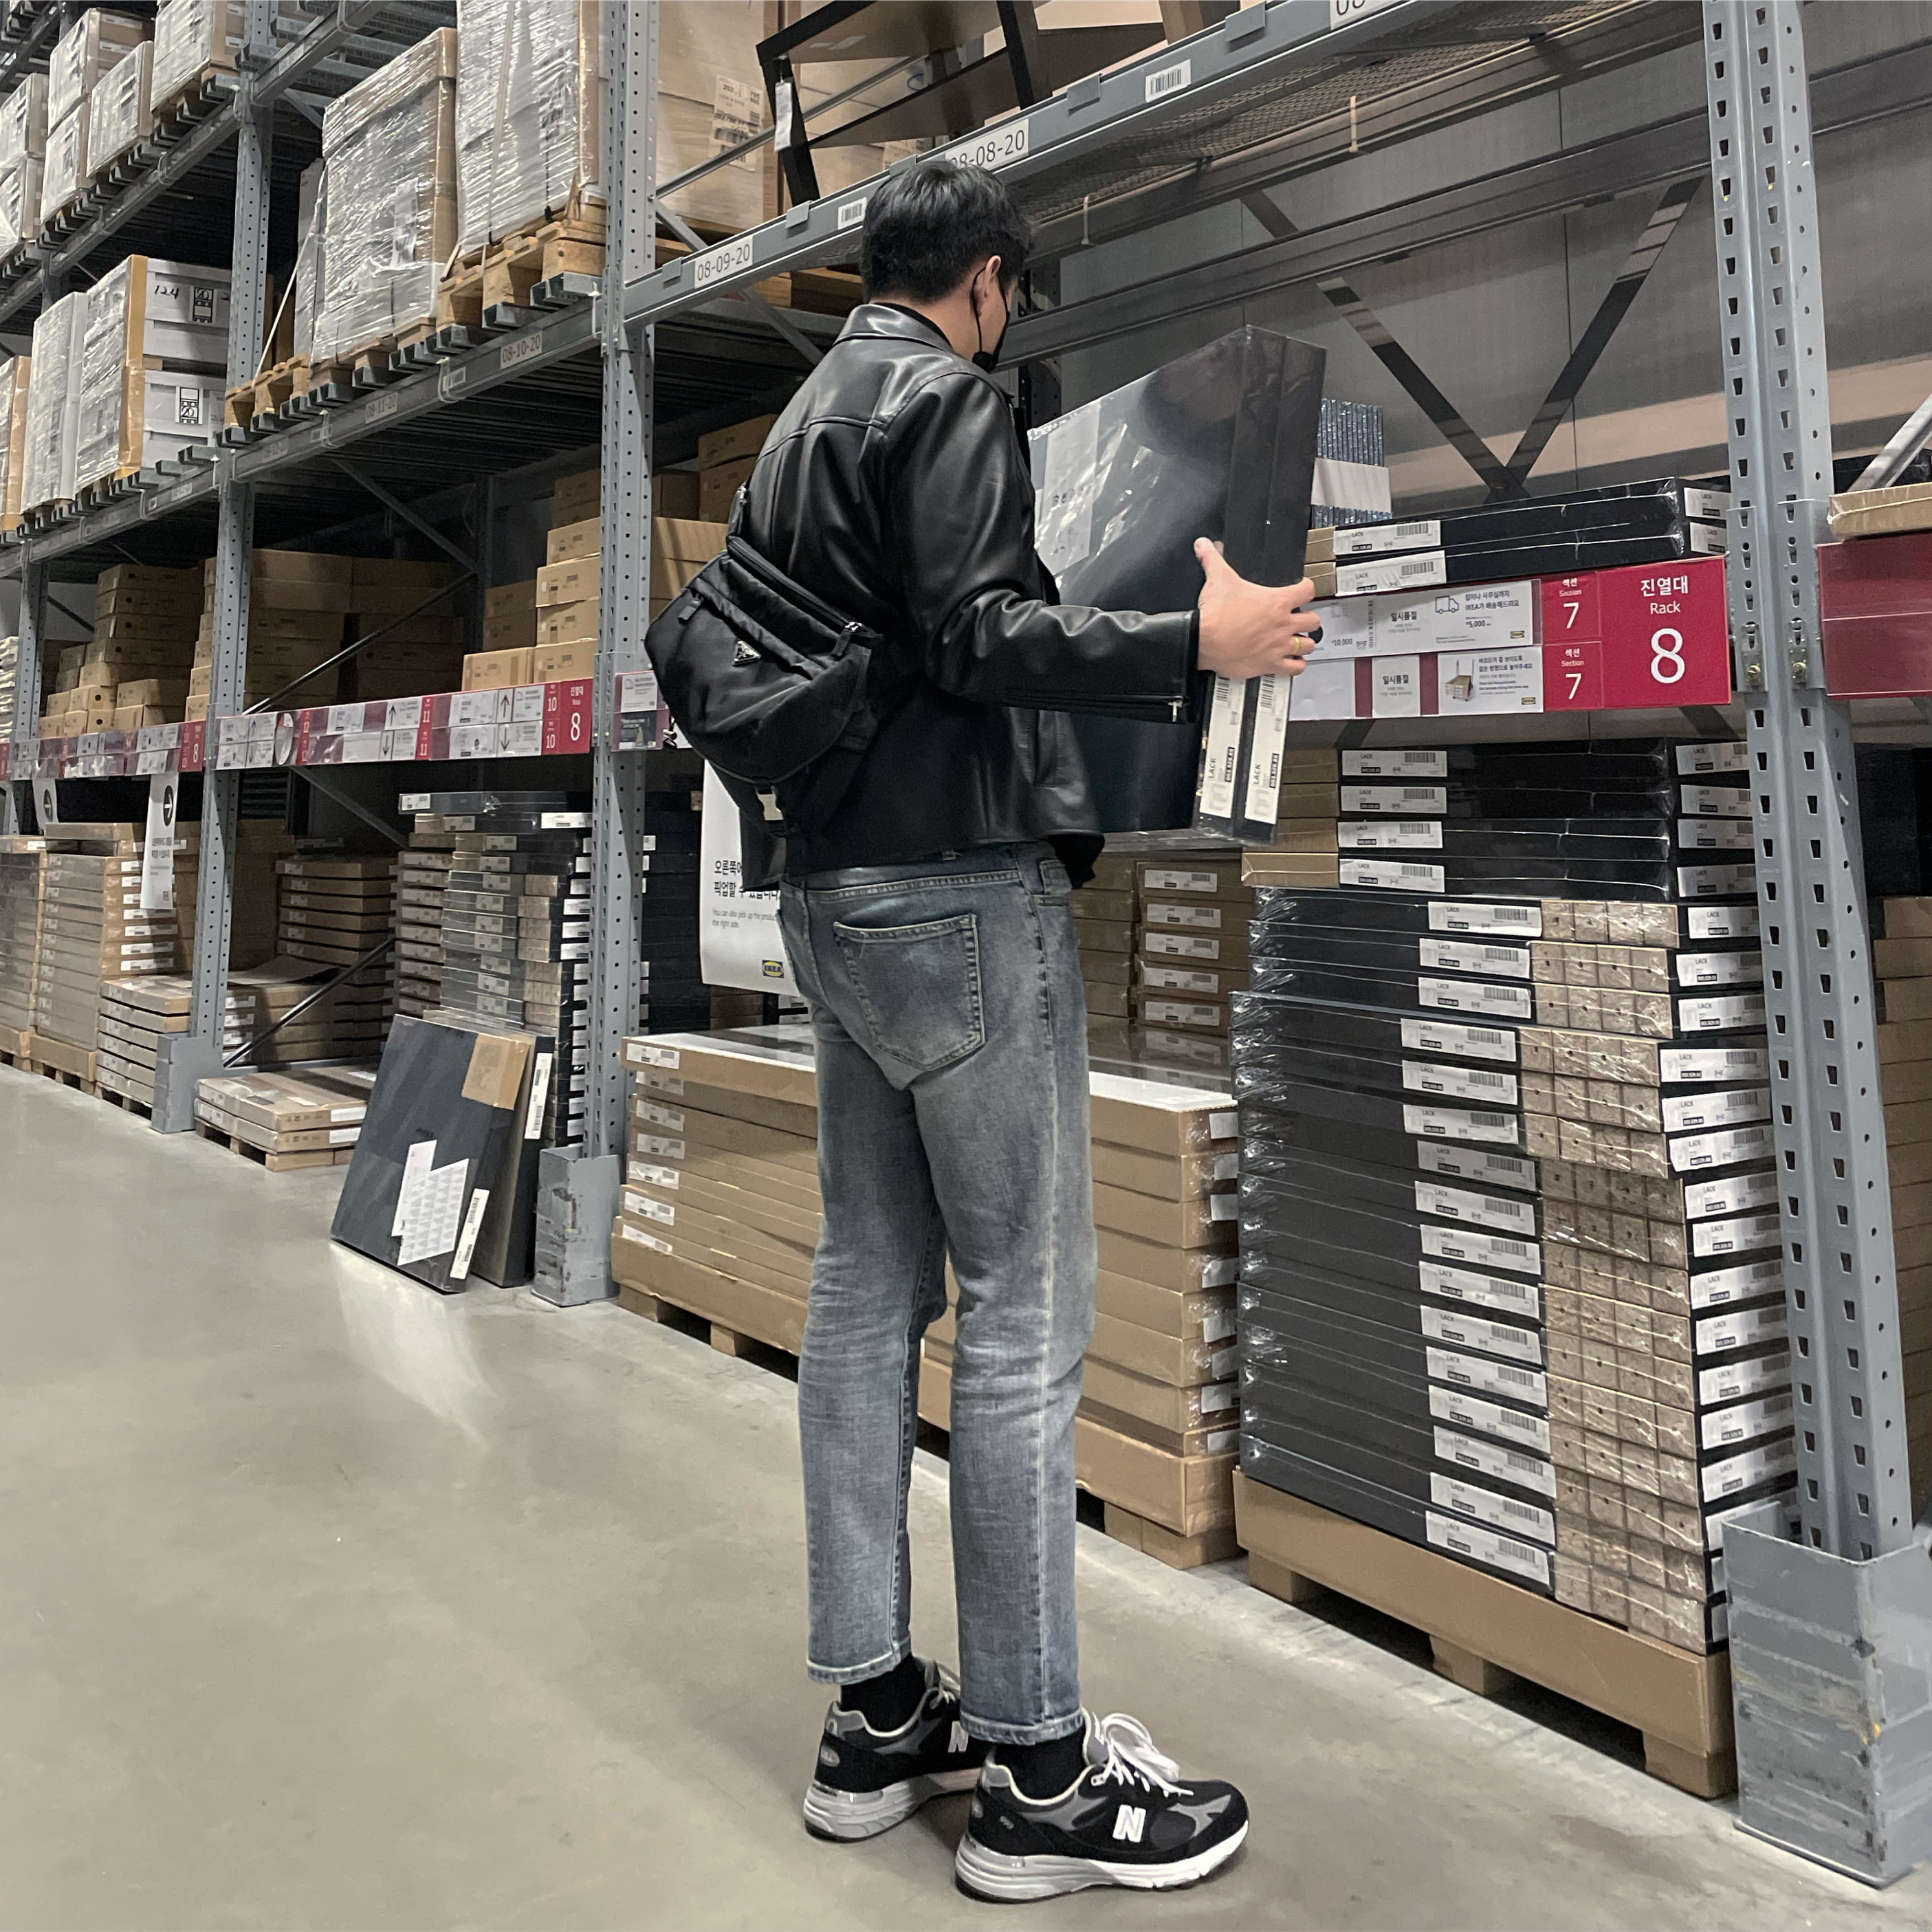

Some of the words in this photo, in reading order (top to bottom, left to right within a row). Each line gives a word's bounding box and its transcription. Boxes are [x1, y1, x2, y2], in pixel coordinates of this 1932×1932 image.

[697, 243, 750, 281] 08-09-20
[502, 333, 541, 363] 08-10-20
[1559, 589, 1582, 597] Section
[1640, 575, 1689, 597] 진열대
[1391, 611, 1417, 622] 일시품절
[1563, 602, 1579, 629] 7
[1650, 601, 1681, 615] Rack
[1651, 628, 1685, 684] 8
[1383, 674, 1409, 685] 일시품절
[1566, 673, 1582, 700] 7
[547, 697, 558, 712] 10
[570, 712, 581, 742] 8
[546, 734, 556, 749] 10
[1208, 758, 1217, 779] LACK
[714, 881, 736, 898] 픽업할
[764, 964, 783, 974] IKEA
[1446, 1355, 1460, 1363] LACK
[1112, 1804, 1146, 1843] N
